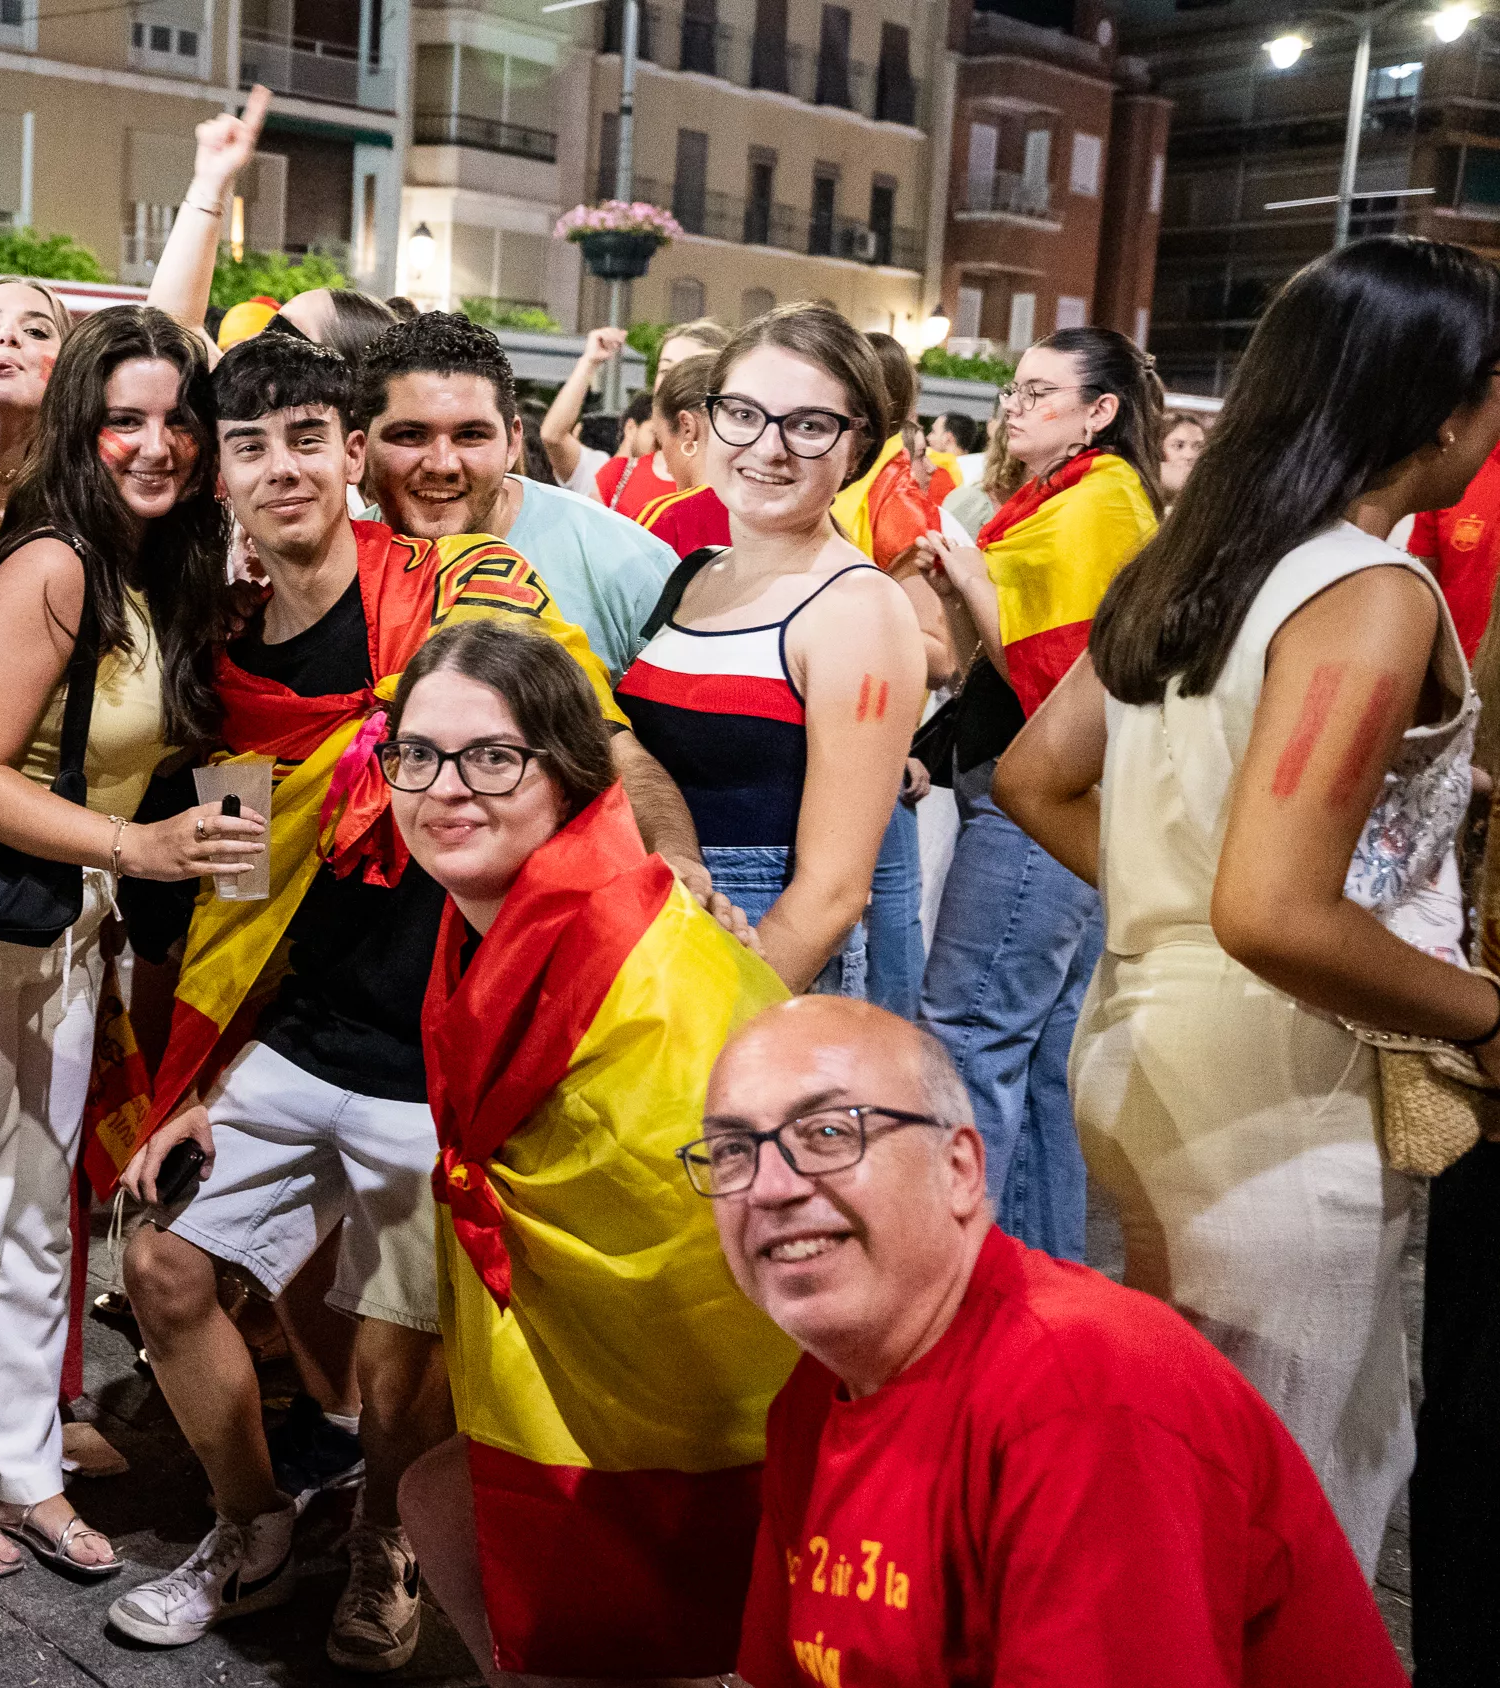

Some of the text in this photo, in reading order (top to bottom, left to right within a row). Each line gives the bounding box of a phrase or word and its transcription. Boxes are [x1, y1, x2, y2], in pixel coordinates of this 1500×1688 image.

[808, 1535, 829, 1593] 2
[856, 1539, 883, 1602] 3
[885, 1561, 910, 1610] la
